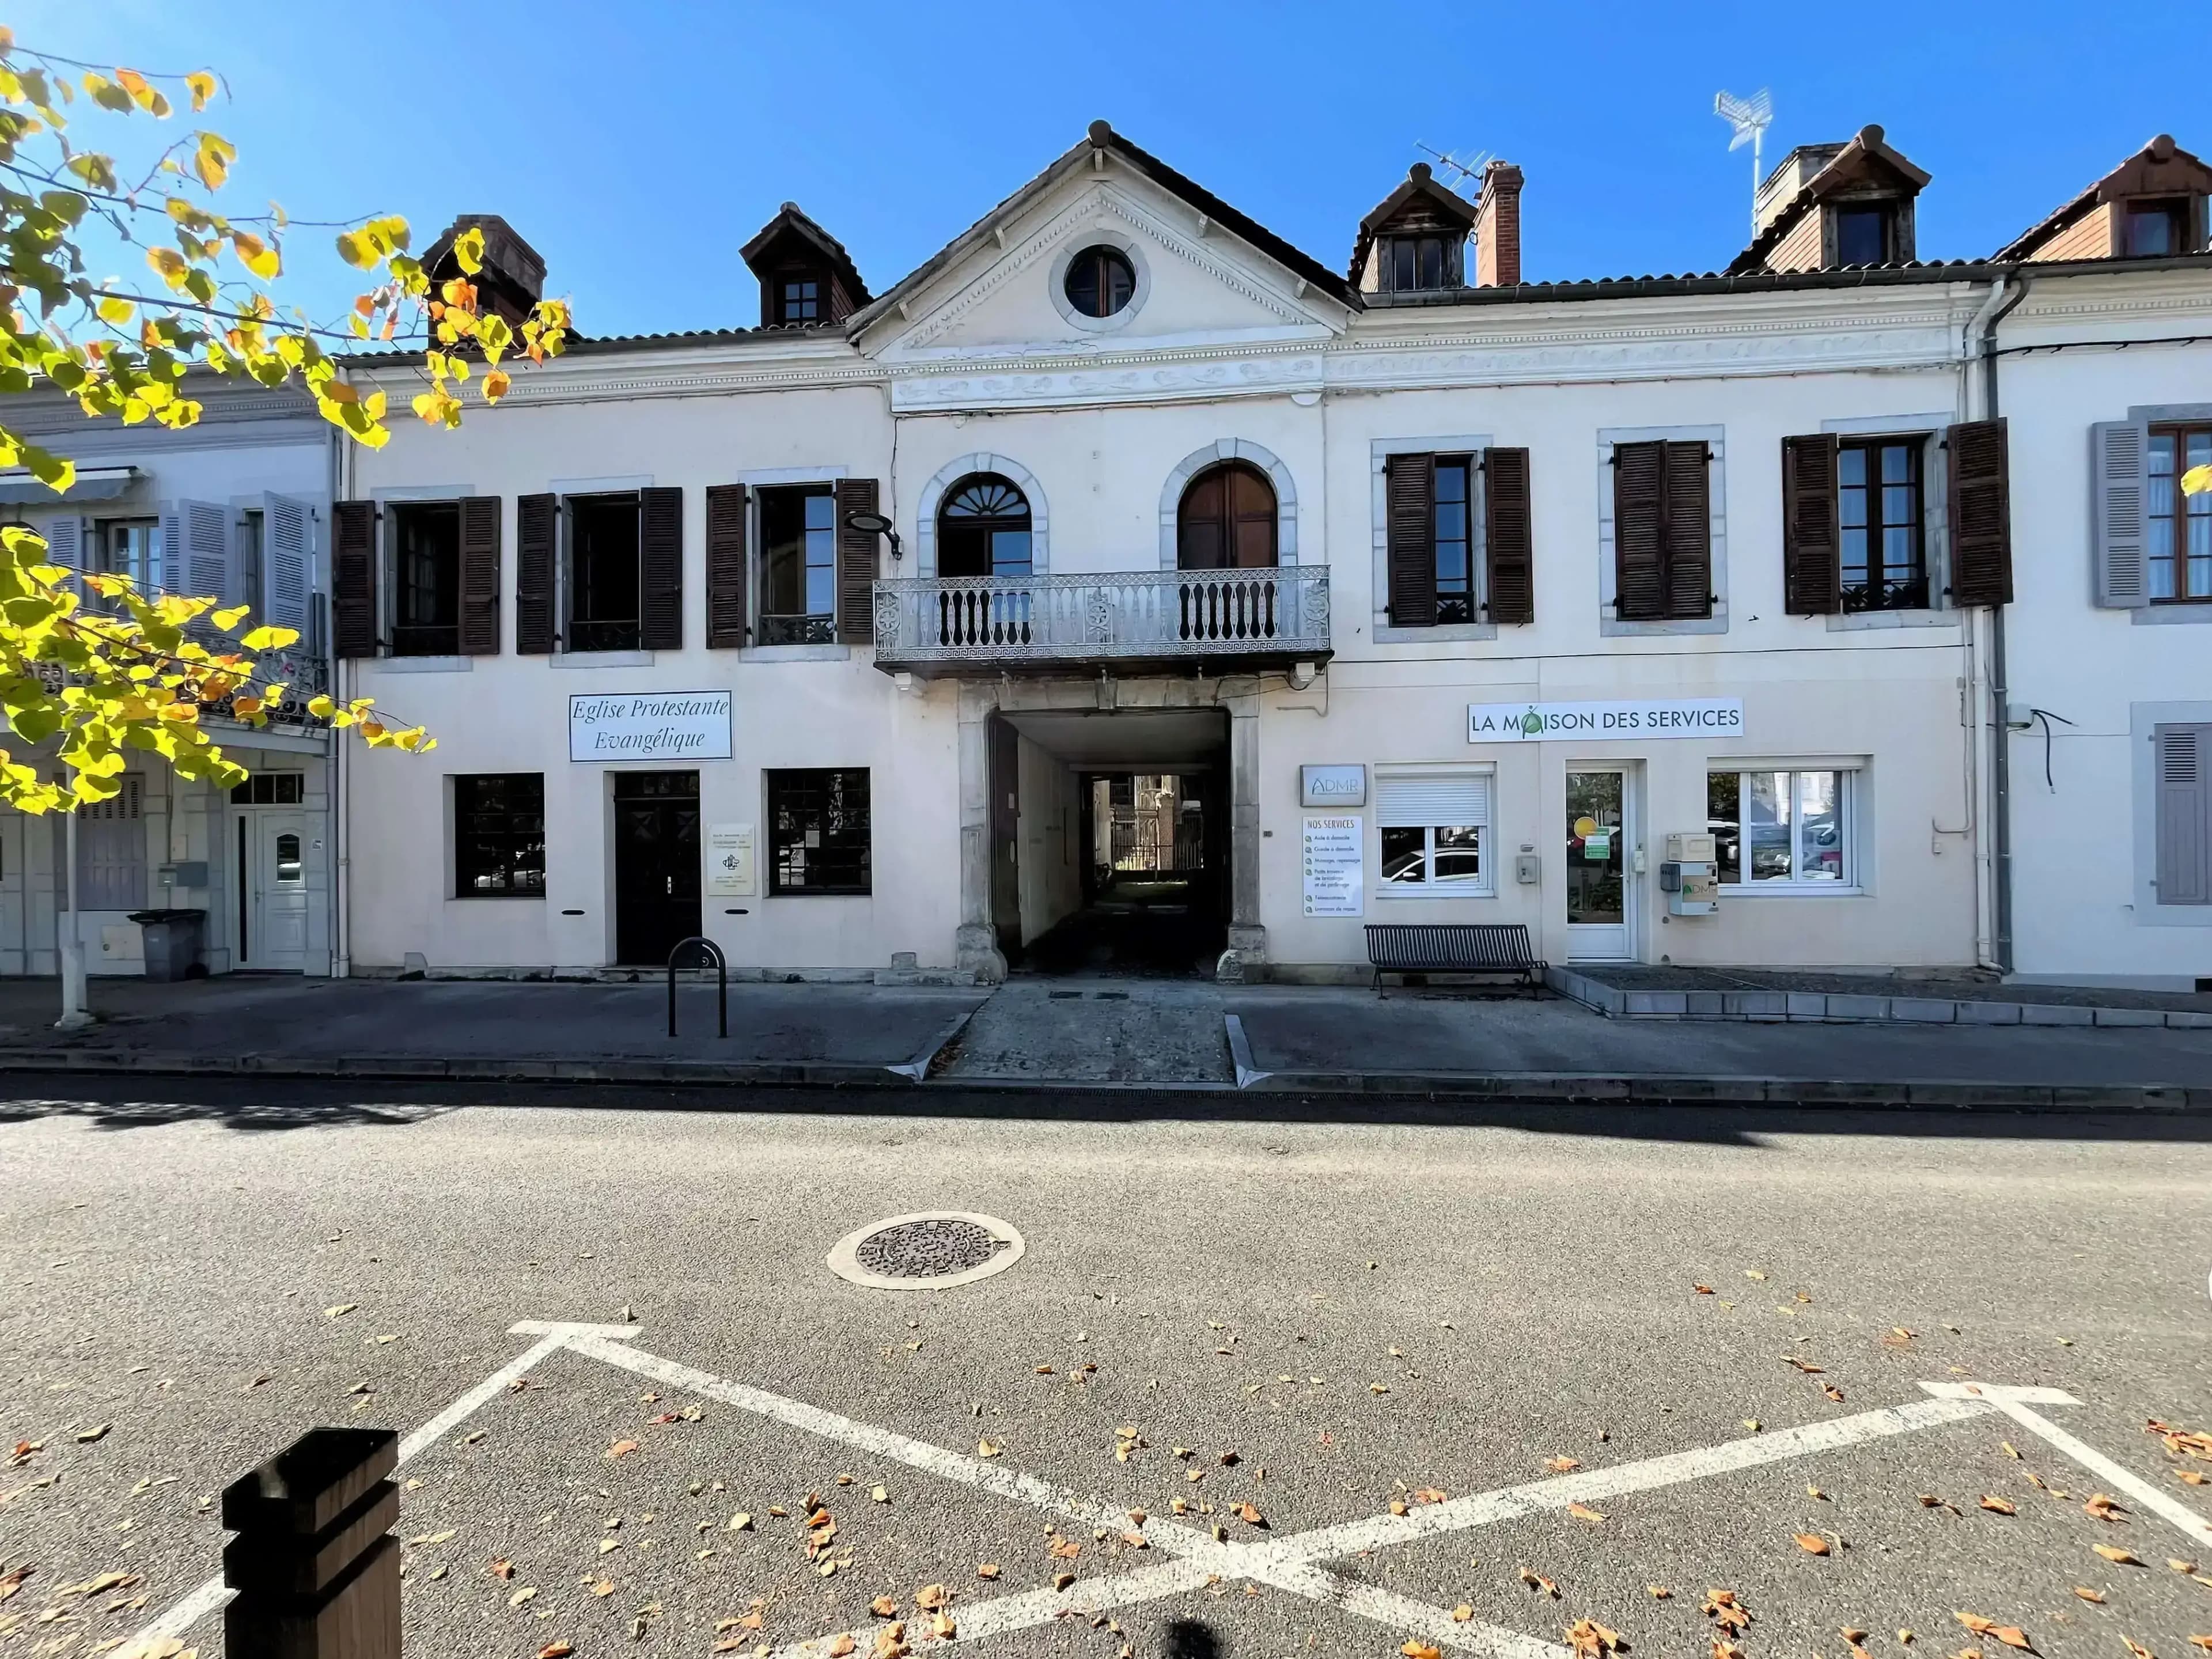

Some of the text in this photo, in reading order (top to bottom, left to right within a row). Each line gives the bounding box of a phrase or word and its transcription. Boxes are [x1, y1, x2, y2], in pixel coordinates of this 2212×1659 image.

[573, 699, 729, 724] Eglise Protestante
[1472, 709, 1740, 738] LA MAISON DES SERVICES
[594, 727, 705, 753] Evangélique
[1312, 778, 1358, 794] ADMR
[1307, 819, 1355, 829] NOS SERVICES
